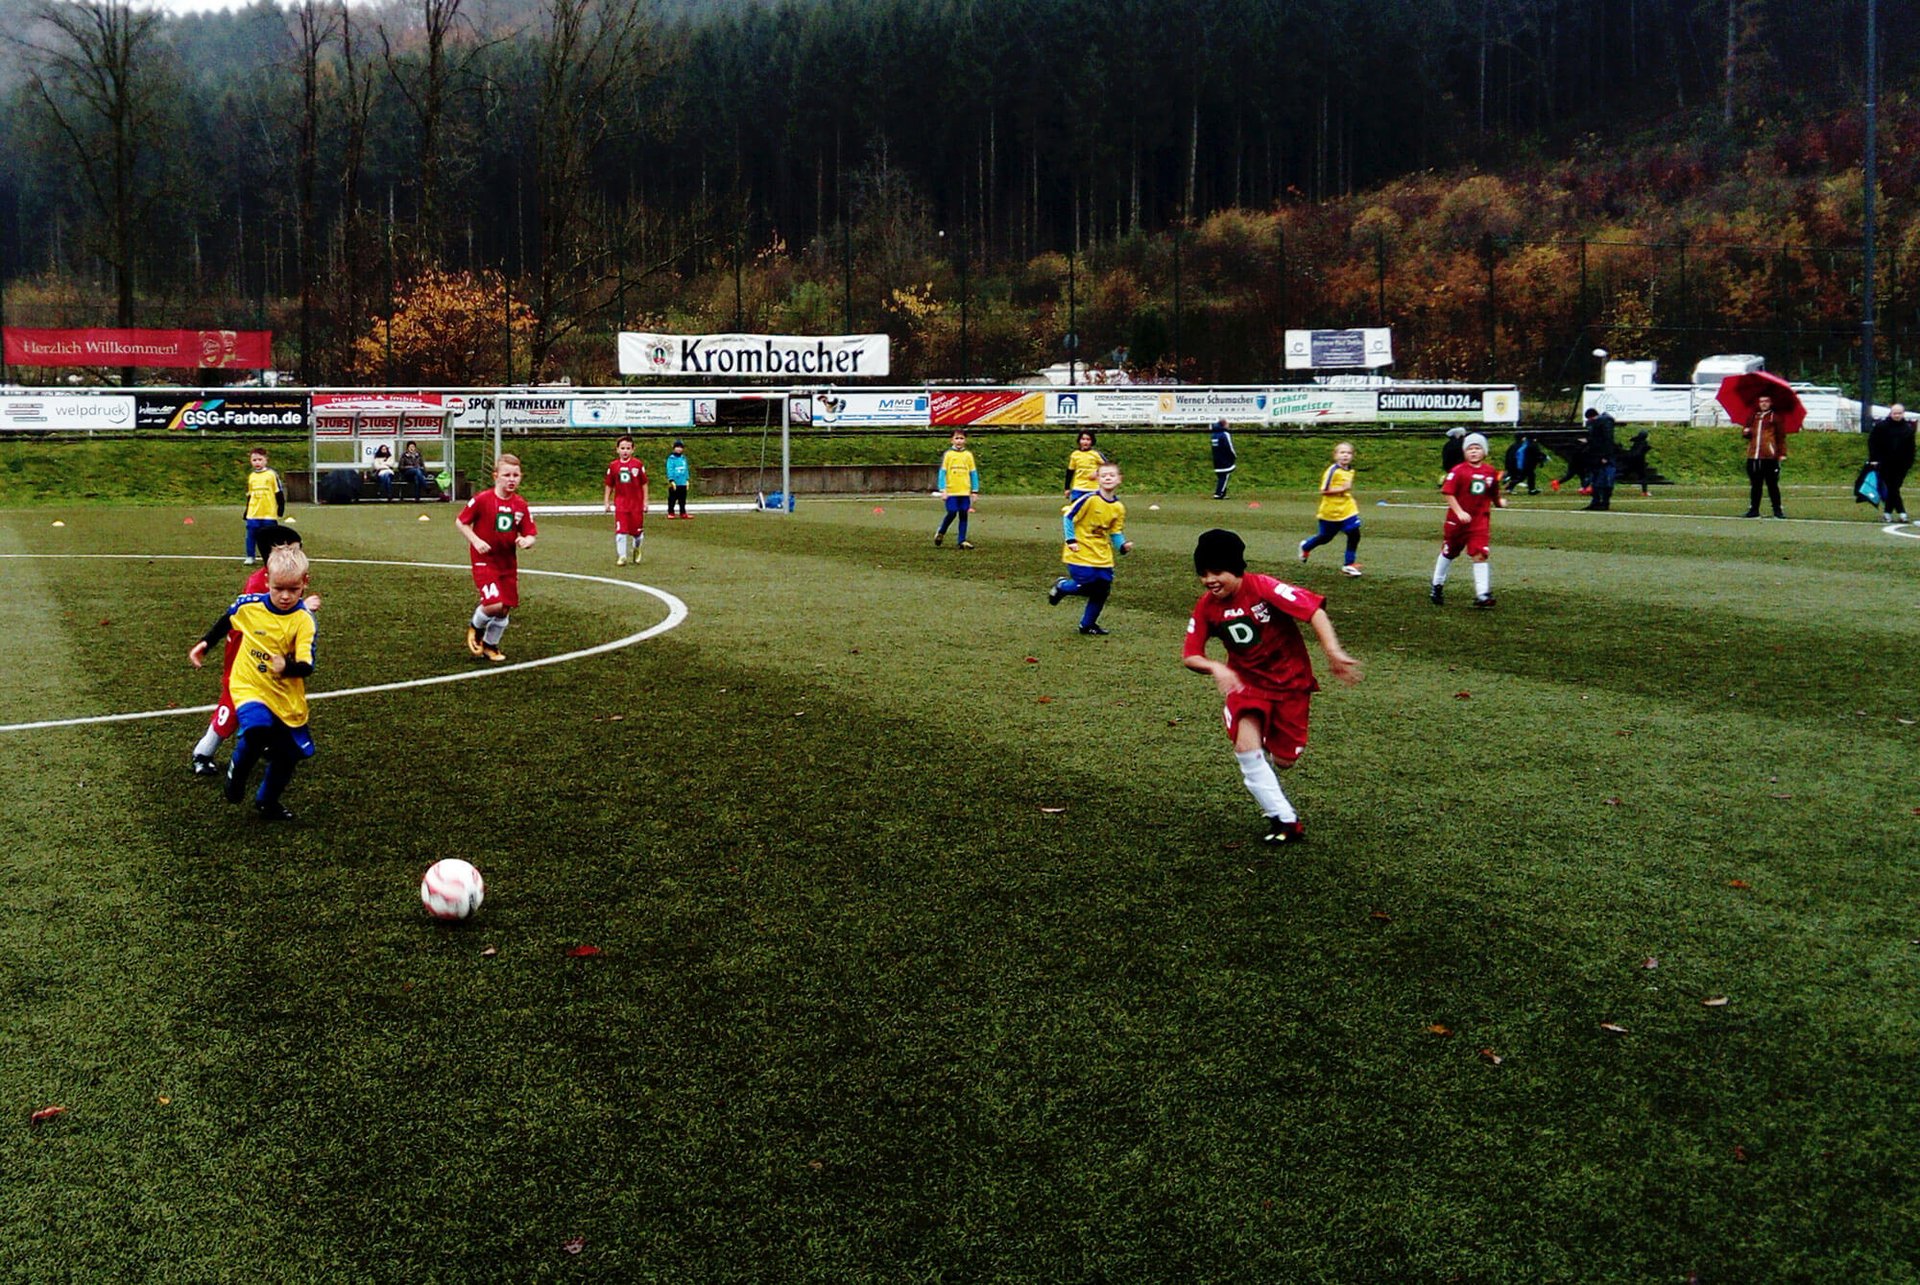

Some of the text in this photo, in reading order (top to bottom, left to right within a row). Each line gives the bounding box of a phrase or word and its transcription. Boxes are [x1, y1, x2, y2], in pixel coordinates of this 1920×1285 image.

[23, 341, 178, 355] Herzlich Willkommen!
[680, 339, 865, 373] Krombacher
[467, 397, 566, 410] SPOR HENNECKEN
[1176, 394, 1254, 405] Werner Schumacher
[1273, 394, 1309, 405] Elektro
[1380, 394, 1482, 410] SHIRTWORLD24.de
[55, 403, 126, 418] welpdruck
[1273, 402, 1335, 417] Gillmeister
[183, 411, 303, 425] GSG-Farben.de
[468, 417, 567, 426] www.sort-hennecken.de
[498, 516, 512, 531] D
[482, 583, 500, 600] 14
[1227, 622, 1254, 644] D
[217, 705, 230, 726] 9
